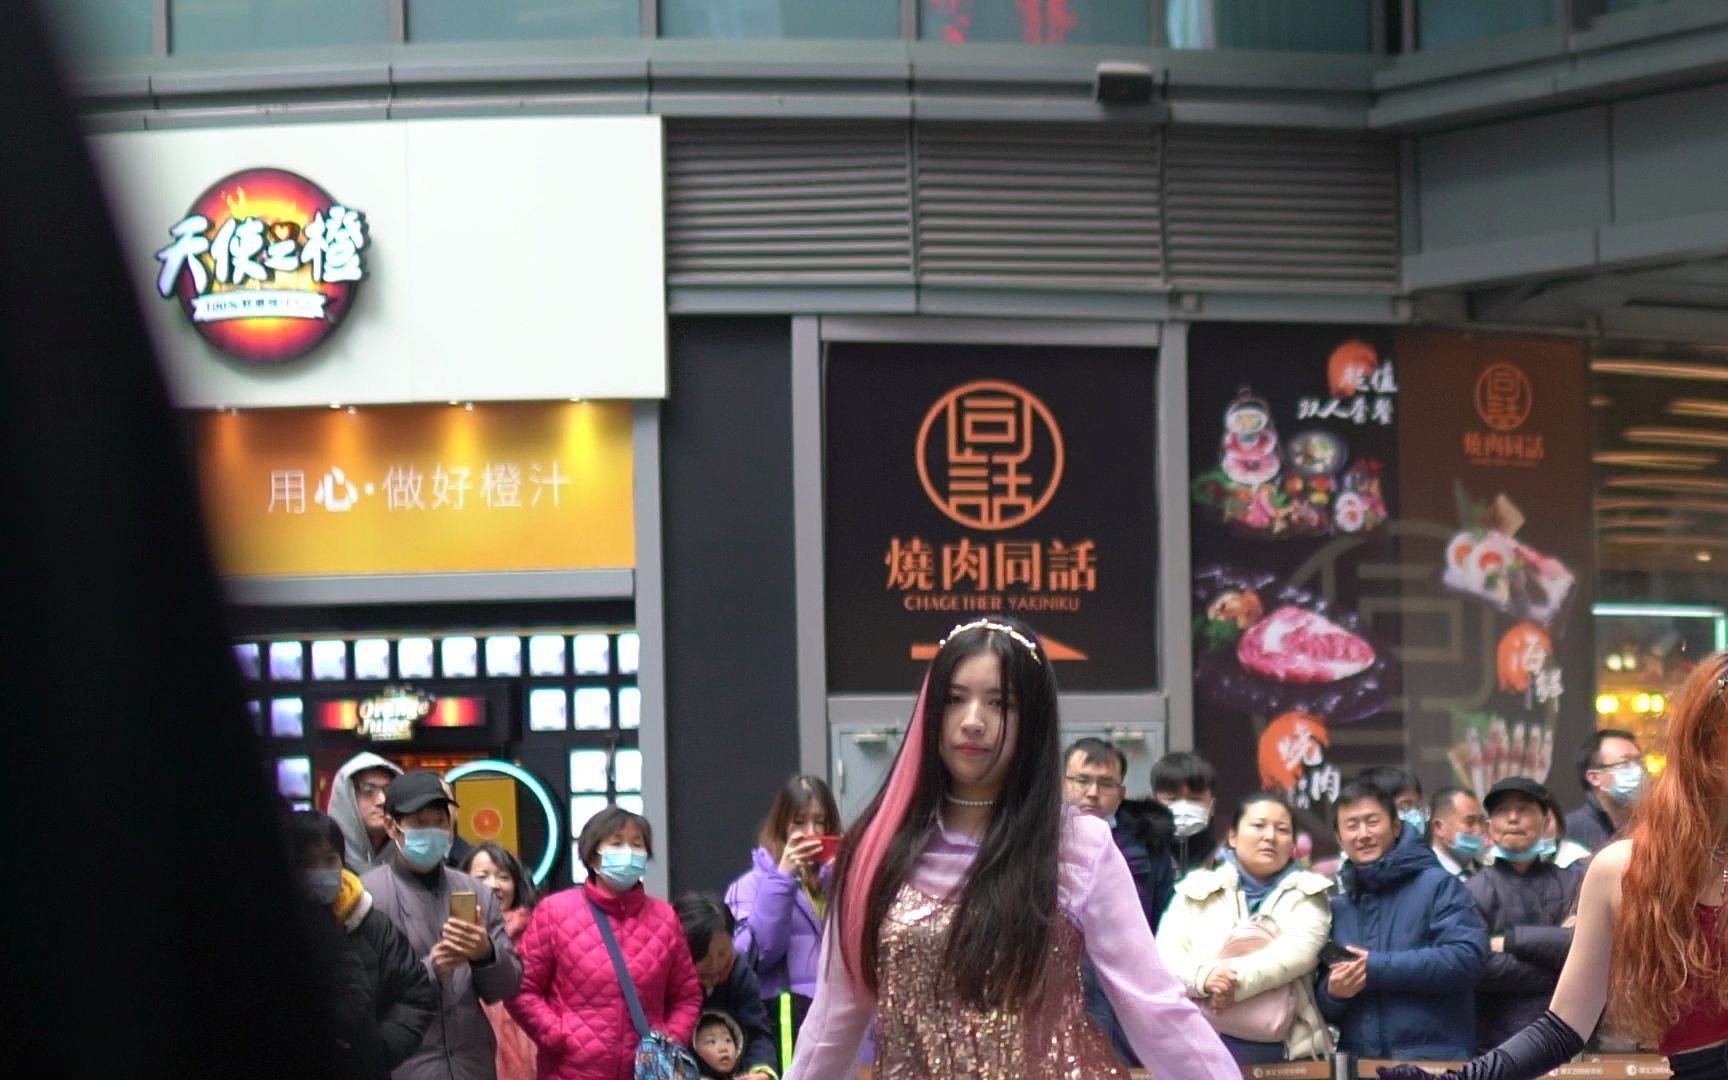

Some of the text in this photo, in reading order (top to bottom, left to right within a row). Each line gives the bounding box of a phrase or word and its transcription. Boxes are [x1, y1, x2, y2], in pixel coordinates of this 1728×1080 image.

[154, 204, 364, 298] 天使之橙
[884, 536, 1097, 591] 燒肉同話
